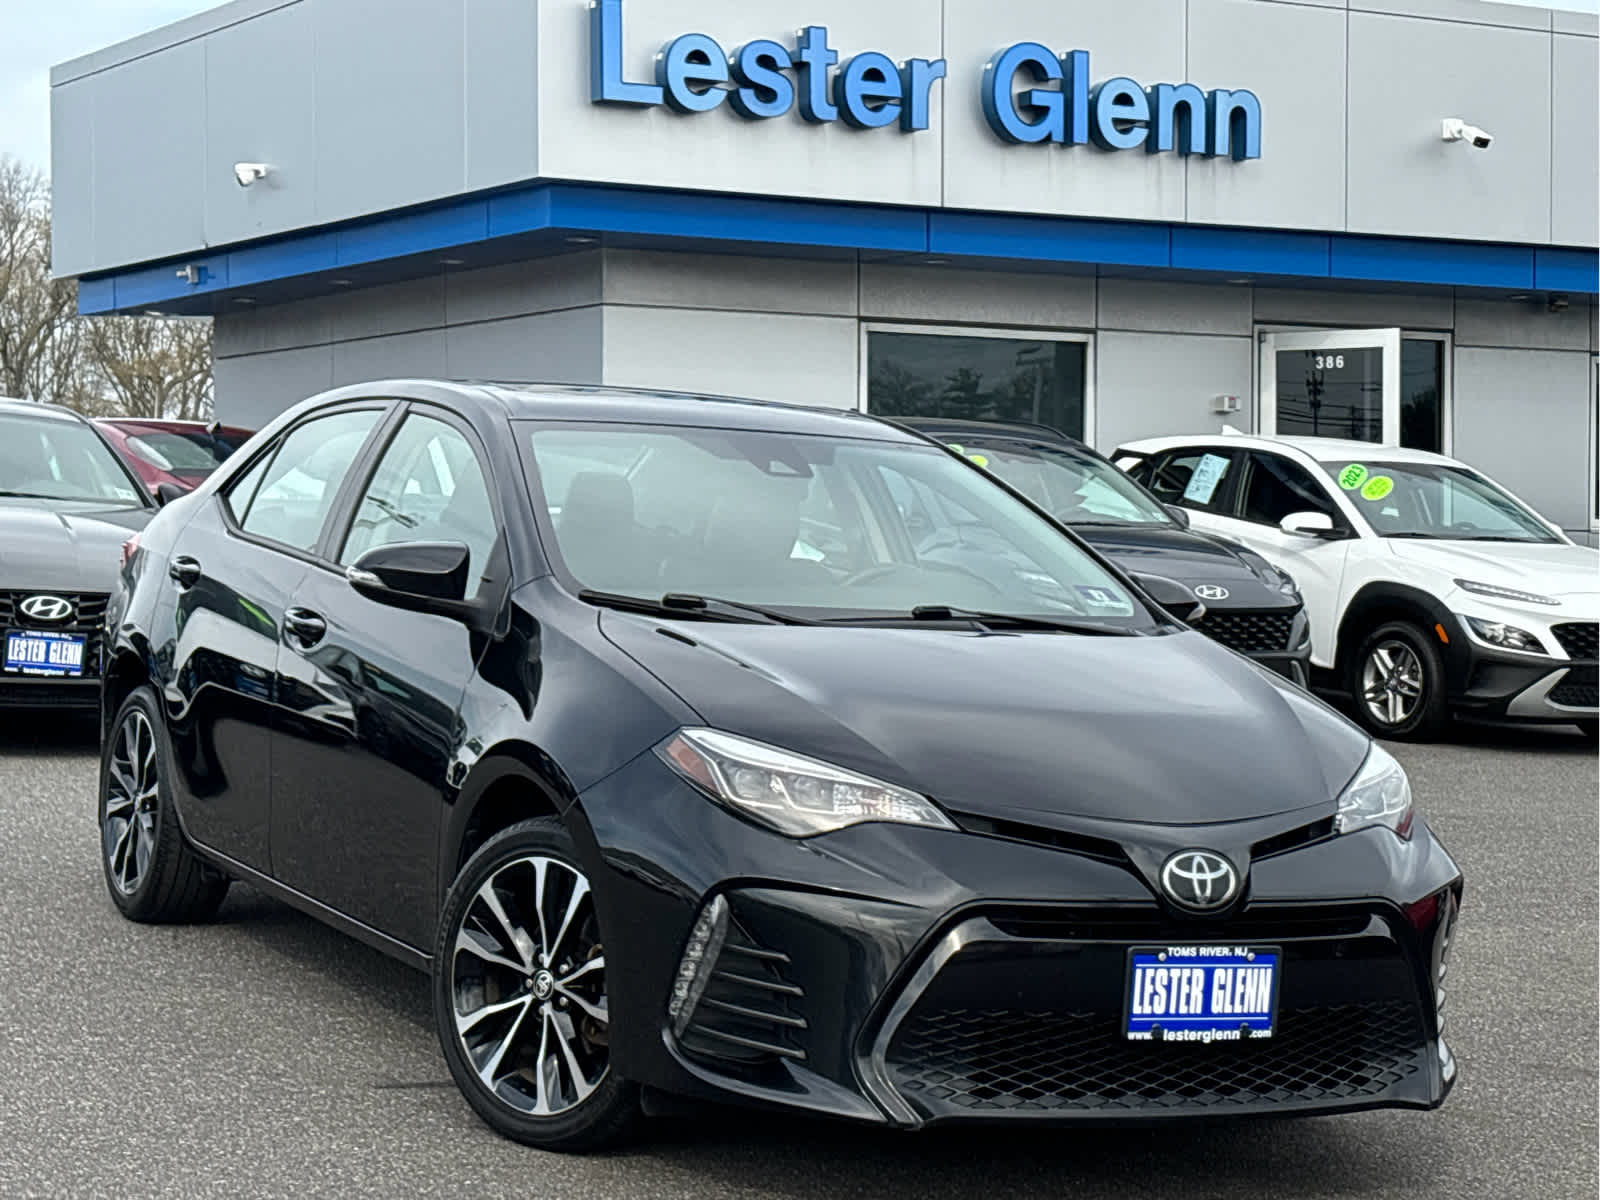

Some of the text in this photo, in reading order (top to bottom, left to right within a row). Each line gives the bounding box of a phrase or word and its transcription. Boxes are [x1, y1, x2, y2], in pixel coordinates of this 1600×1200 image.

[590, 0, 1261, 161] Lester Glenn
[1315, 355, 1345, 369] 386
[8, 639, 83, 665] LESTER GLENN
[1167, 947, 1197, 957] TOMS
[1234, 946, 1248, 957] NJ
[1132, 968, 1273, 1015] LESTER GLENN
[1162, 1028, 1241, 1044] lesterglenn
